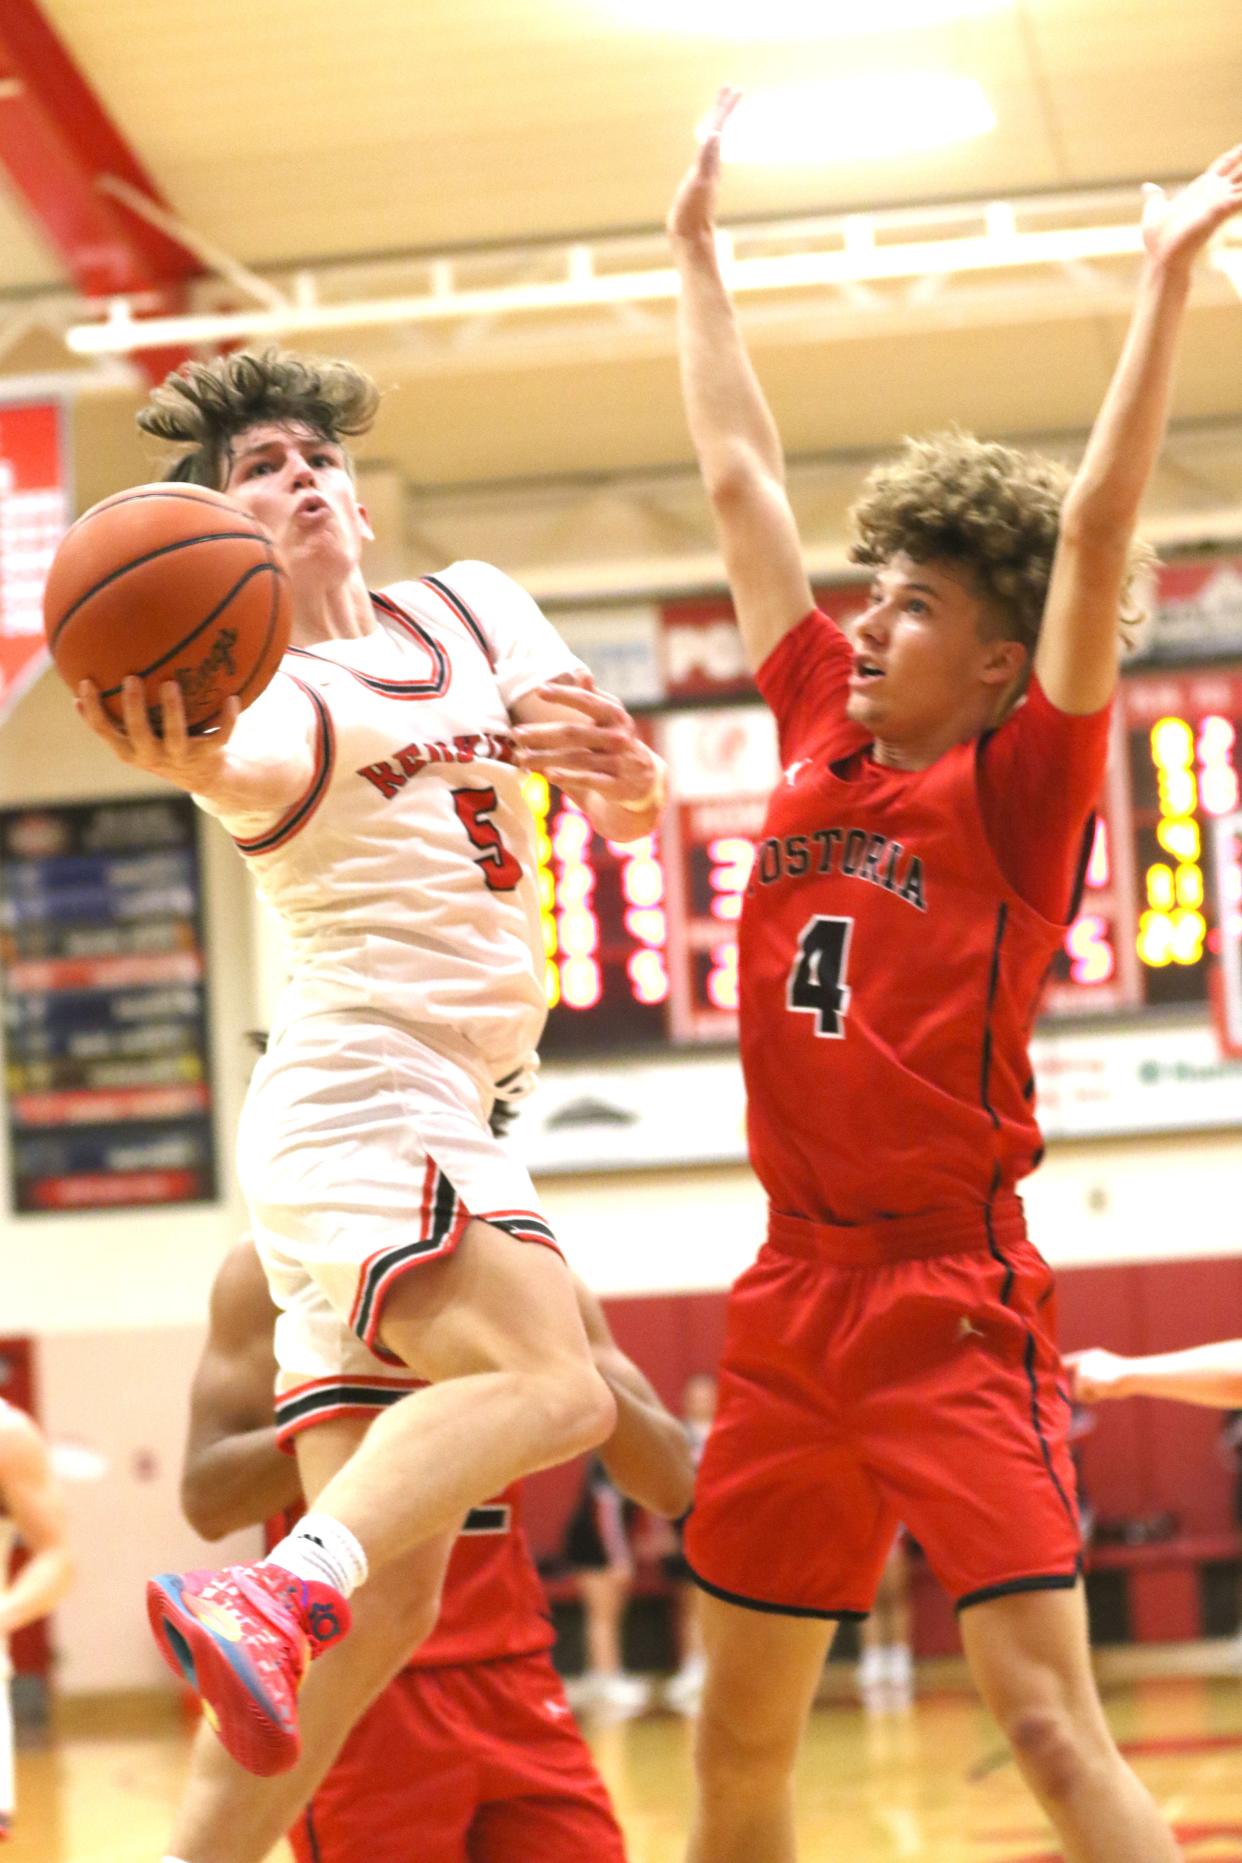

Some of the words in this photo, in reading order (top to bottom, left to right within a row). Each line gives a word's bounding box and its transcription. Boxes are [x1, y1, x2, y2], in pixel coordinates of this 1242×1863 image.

[451, 786, 523, 891] 5
[748, 827, 928, 913] OSTORIA
[786, 914, 855, 1039] 4
